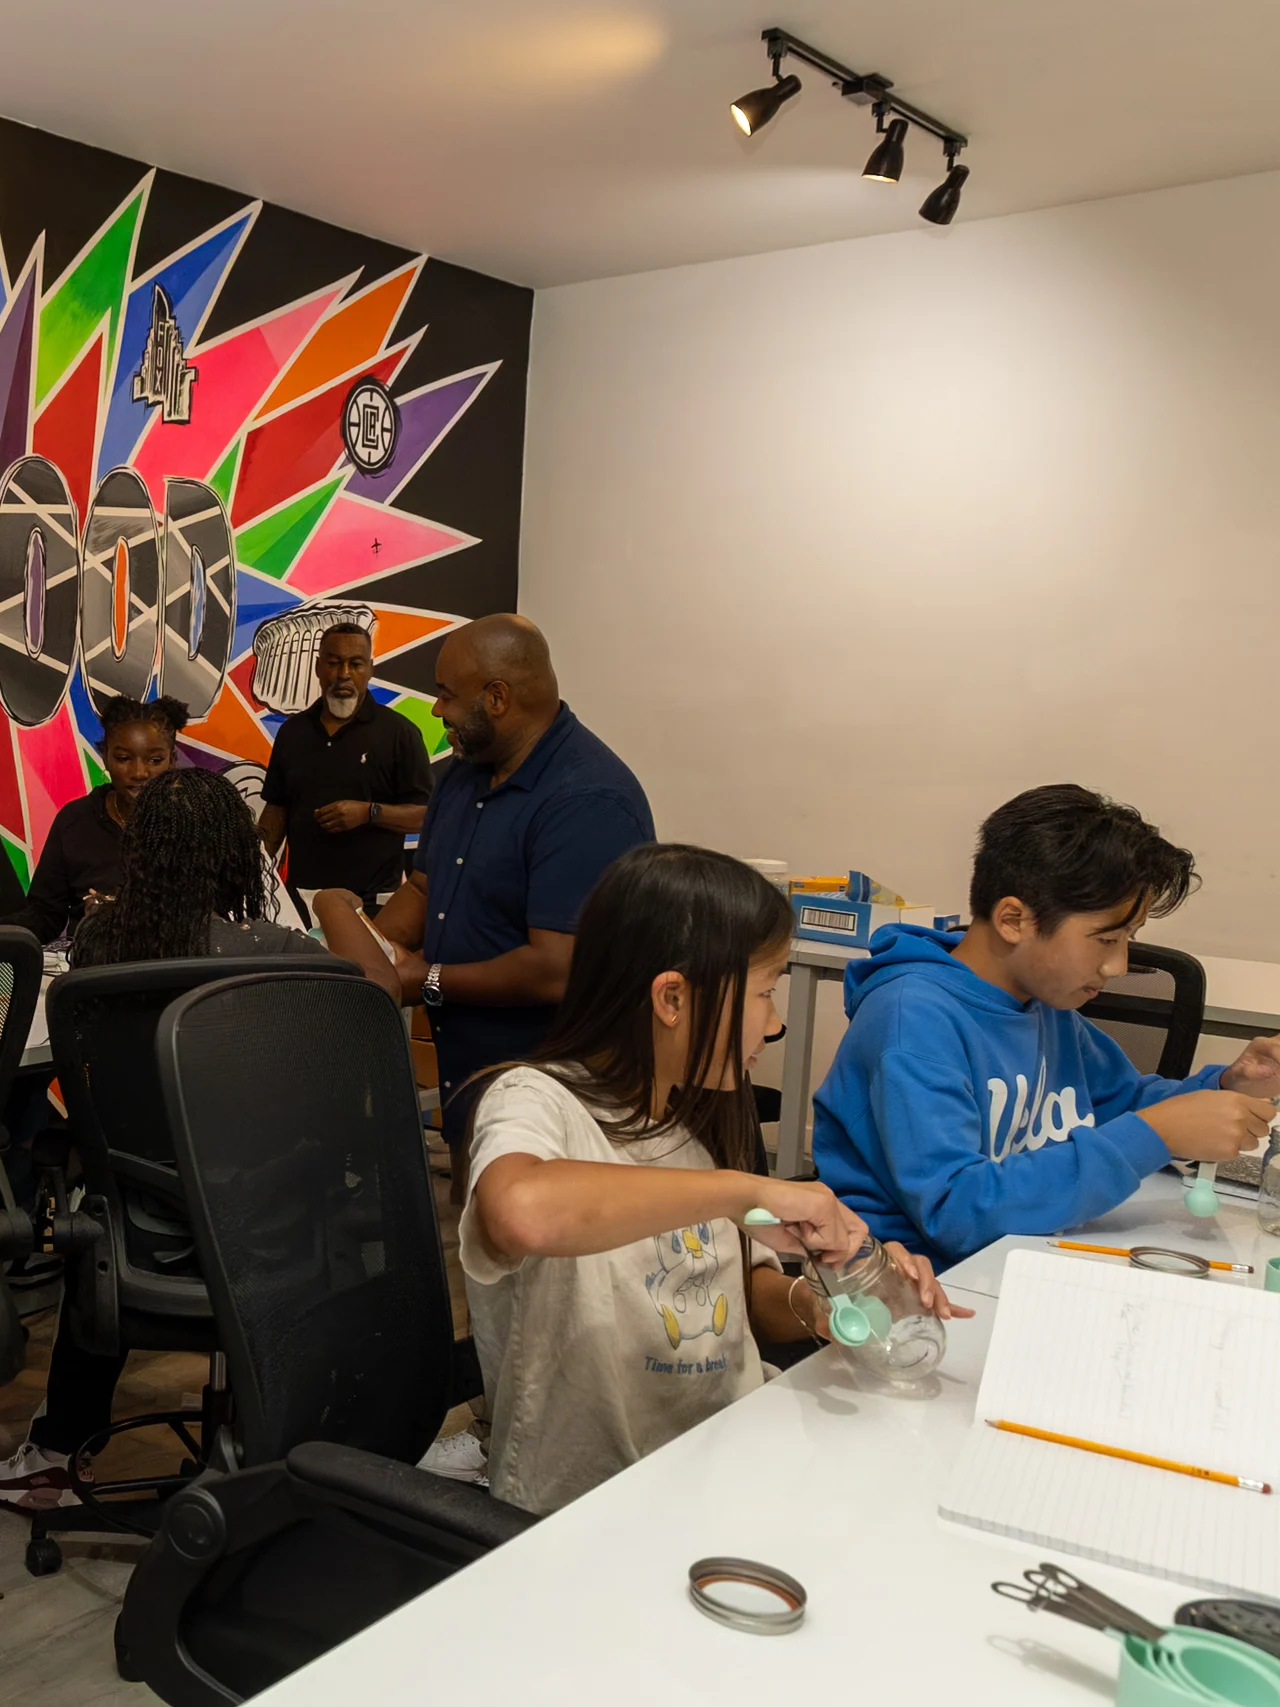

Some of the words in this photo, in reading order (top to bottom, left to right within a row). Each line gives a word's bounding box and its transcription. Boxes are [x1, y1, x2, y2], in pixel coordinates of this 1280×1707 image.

[154, 321, 164, 392] FOX
[644, 1356, 673, 1374] Time
[676, 1358, 694, 1375] for
